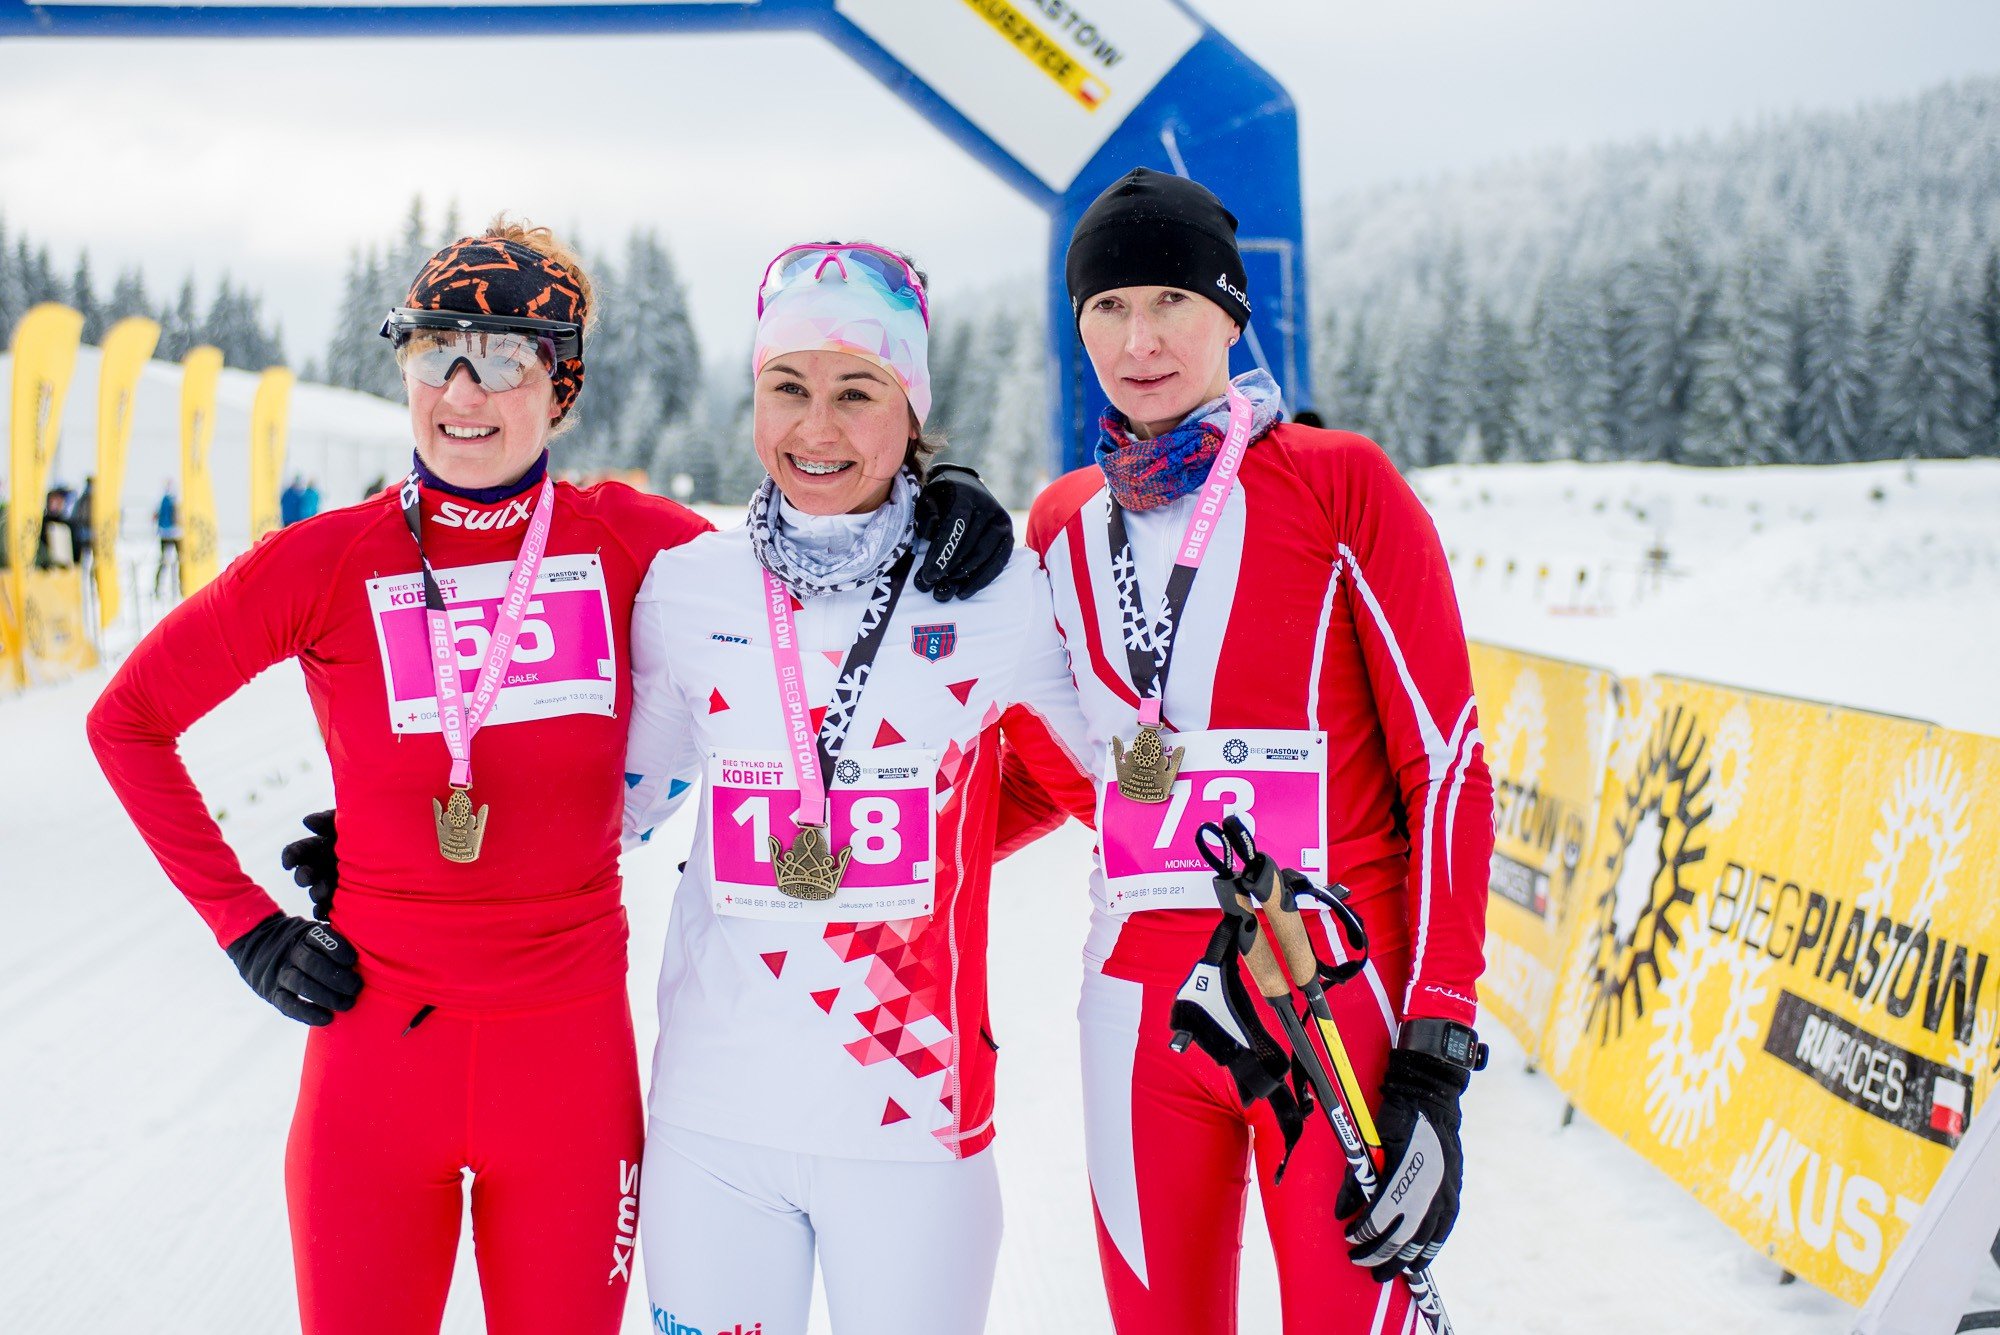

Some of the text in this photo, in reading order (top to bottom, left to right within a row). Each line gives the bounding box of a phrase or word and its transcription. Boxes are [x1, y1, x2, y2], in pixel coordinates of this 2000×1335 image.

[1184, 518, 1210, 560] BIEG
[1201, 483, 1226, 516] DLA
[1217, 421, 1247, 480] KOBIET
[440, 578, 456, 586] DLA
[390, 586, 458, 606] KOBET
[448, 600, 556, 671] 55
[433, 618, 465, 760] BIEG DLA KOBIE
[468, 633, 511, 728] BIEGPIASTÓ
[507, 672, 539, 685] GAŁEK
[782, 665, 817, 781] BIEGPIASTÓW
[722, 759, 738, 767] BIEG
[741, 760, 765, 768] TYLKO
[722, 769, 784, 785] KOBIET
[1153, 777, 1256, 849] 73
[1165, 859, 1201, 869] MONIKA
[1169, 886, 1185, 895] 221
[309, 926, 338, 950] OKO
